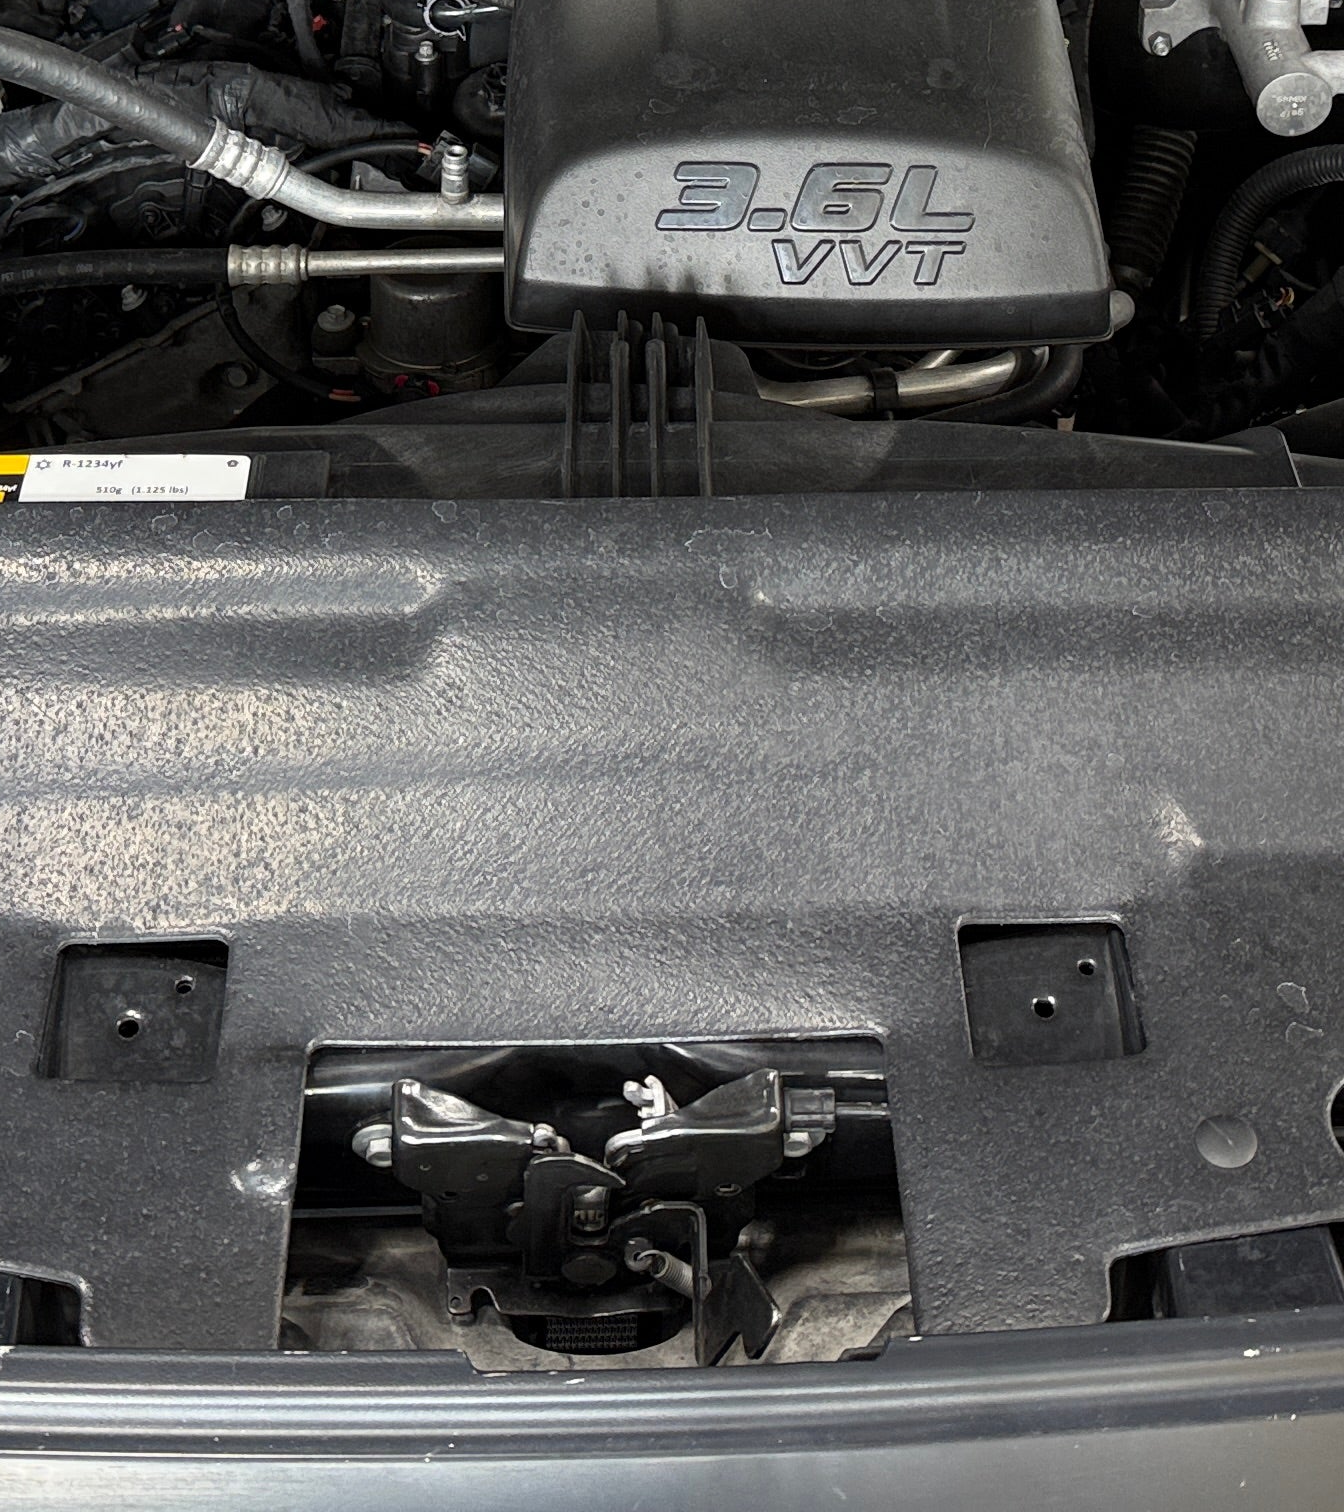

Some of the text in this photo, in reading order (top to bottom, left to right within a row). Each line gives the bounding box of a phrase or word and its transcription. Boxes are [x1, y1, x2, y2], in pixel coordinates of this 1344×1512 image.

[655, 161, 975, 234] 3.6L
[770, 238, 968, 287] VVT
[62, 459, 124, 469] R-1234yf
[95, 486, 123, 495] 510g
